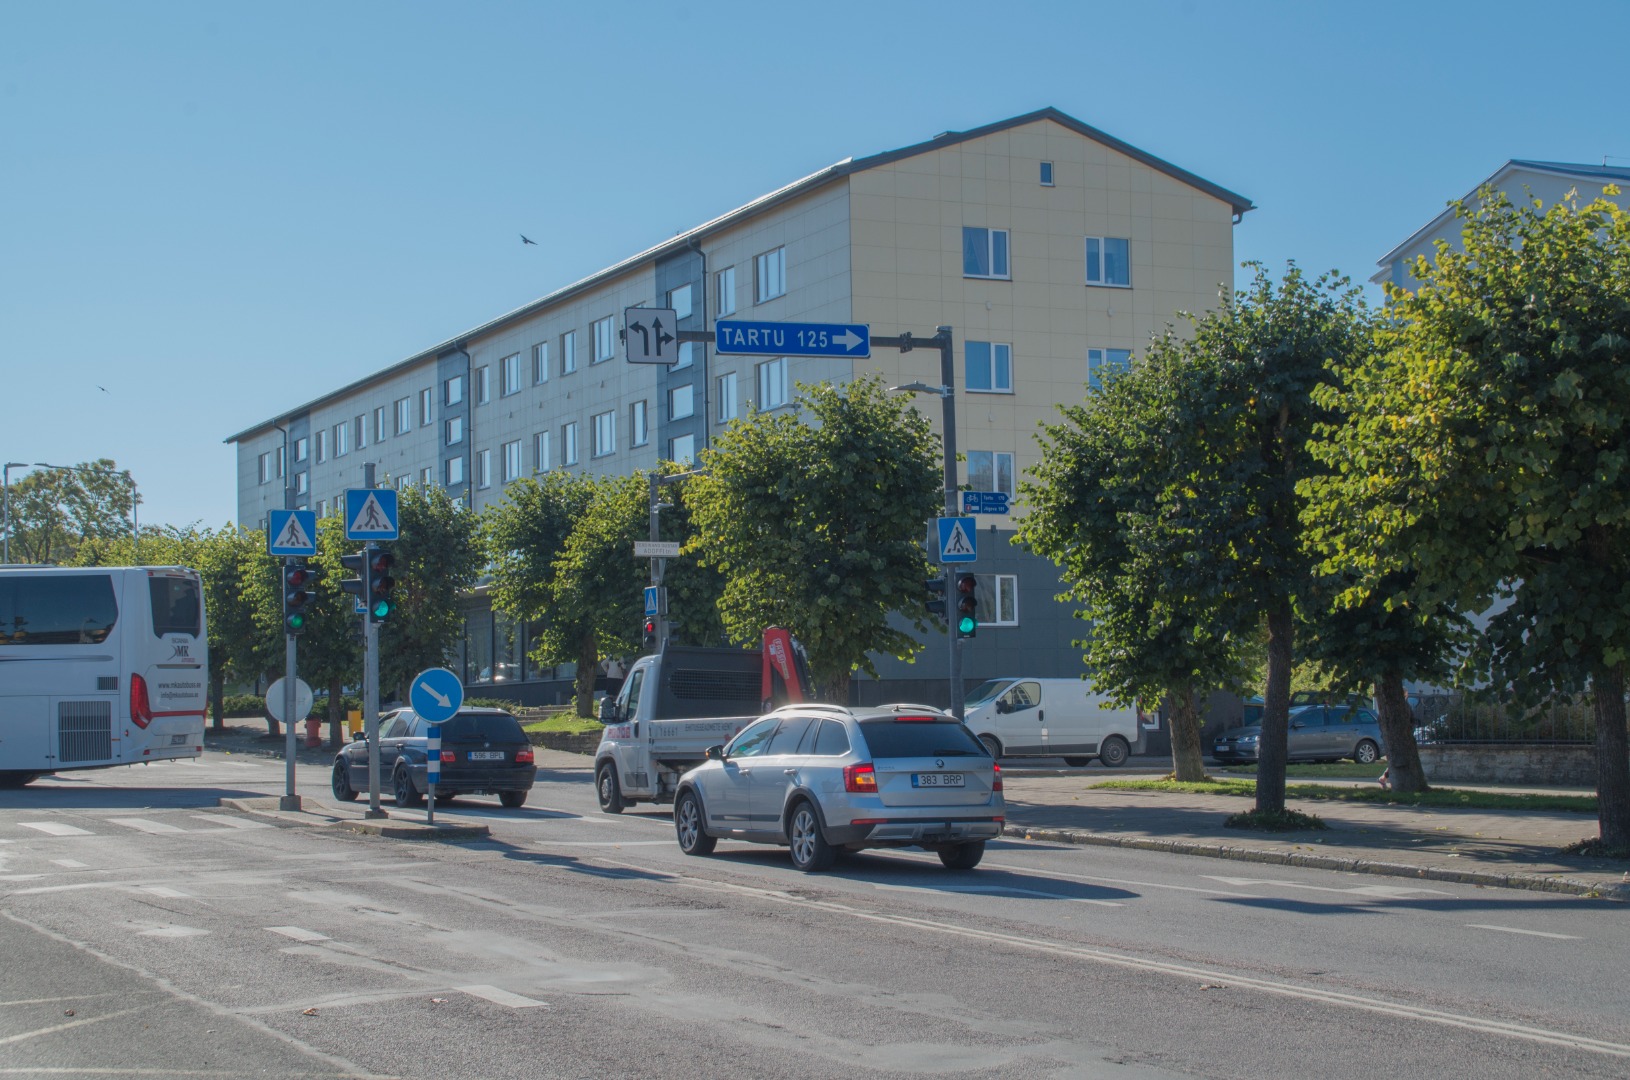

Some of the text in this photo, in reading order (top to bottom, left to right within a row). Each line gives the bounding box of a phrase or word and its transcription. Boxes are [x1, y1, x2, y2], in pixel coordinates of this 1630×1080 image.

[722, 328, 828, 348] TARTU 125
[176, 645, 189, 657] MK
[158, 681, 201, 689] www.mkautobuss.ee
[921, 775, 962, 785] 383 BRP
